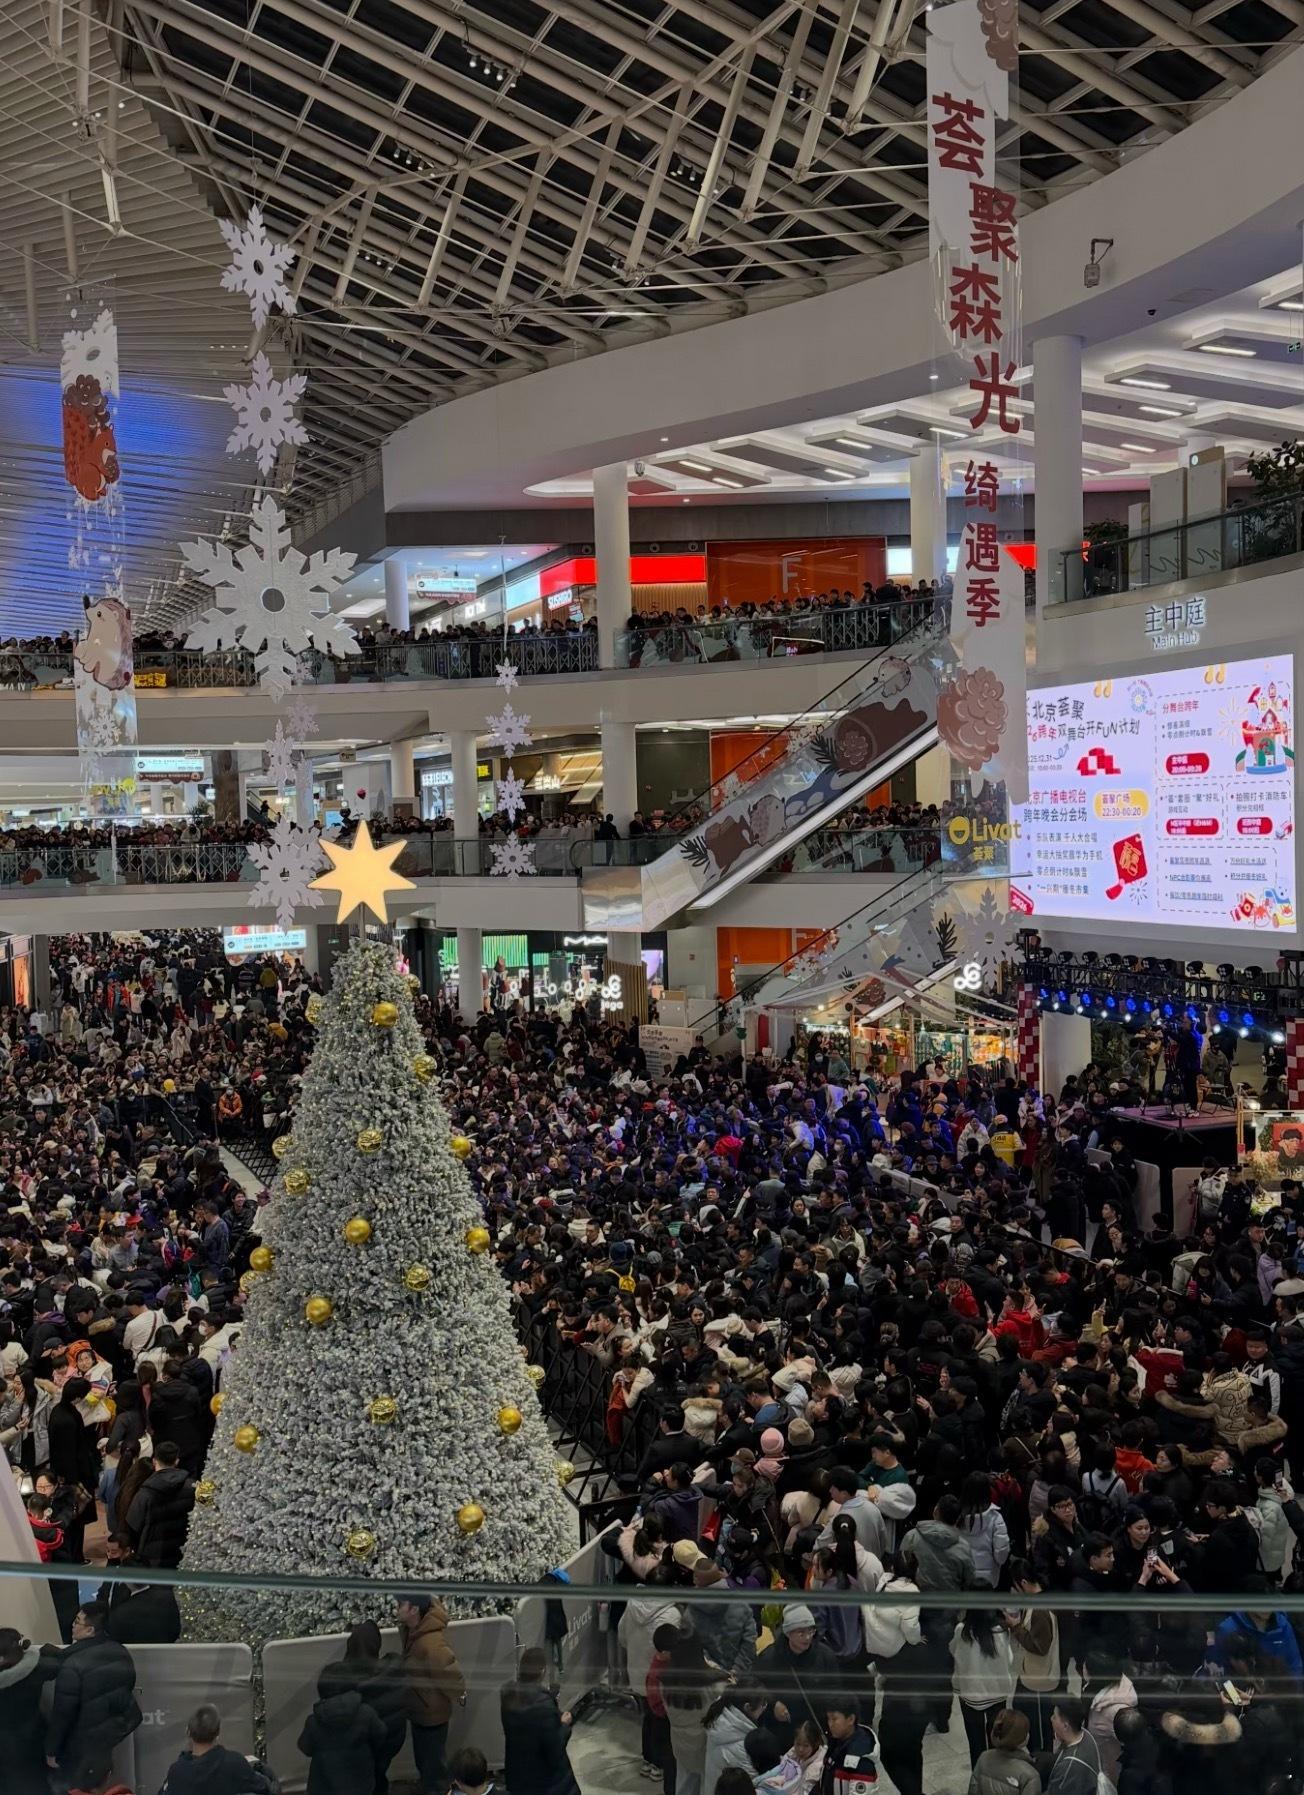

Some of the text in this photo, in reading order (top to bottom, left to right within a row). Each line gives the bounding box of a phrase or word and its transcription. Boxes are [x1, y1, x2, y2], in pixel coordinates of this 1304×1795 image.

[932, 92, 1020, 434] 荟聚森光
[964, 459, 1001, 628] 绮遇季
[1144, 598, 1204, 633] 主中庭
[1152, 634, 1176, 649] Main
[1027, 696, 1085, 722] 北京荟聚
[1024, 807, 1087, 822] 跨年晚会分会场
[972, 816, 1022, 842] Livat
